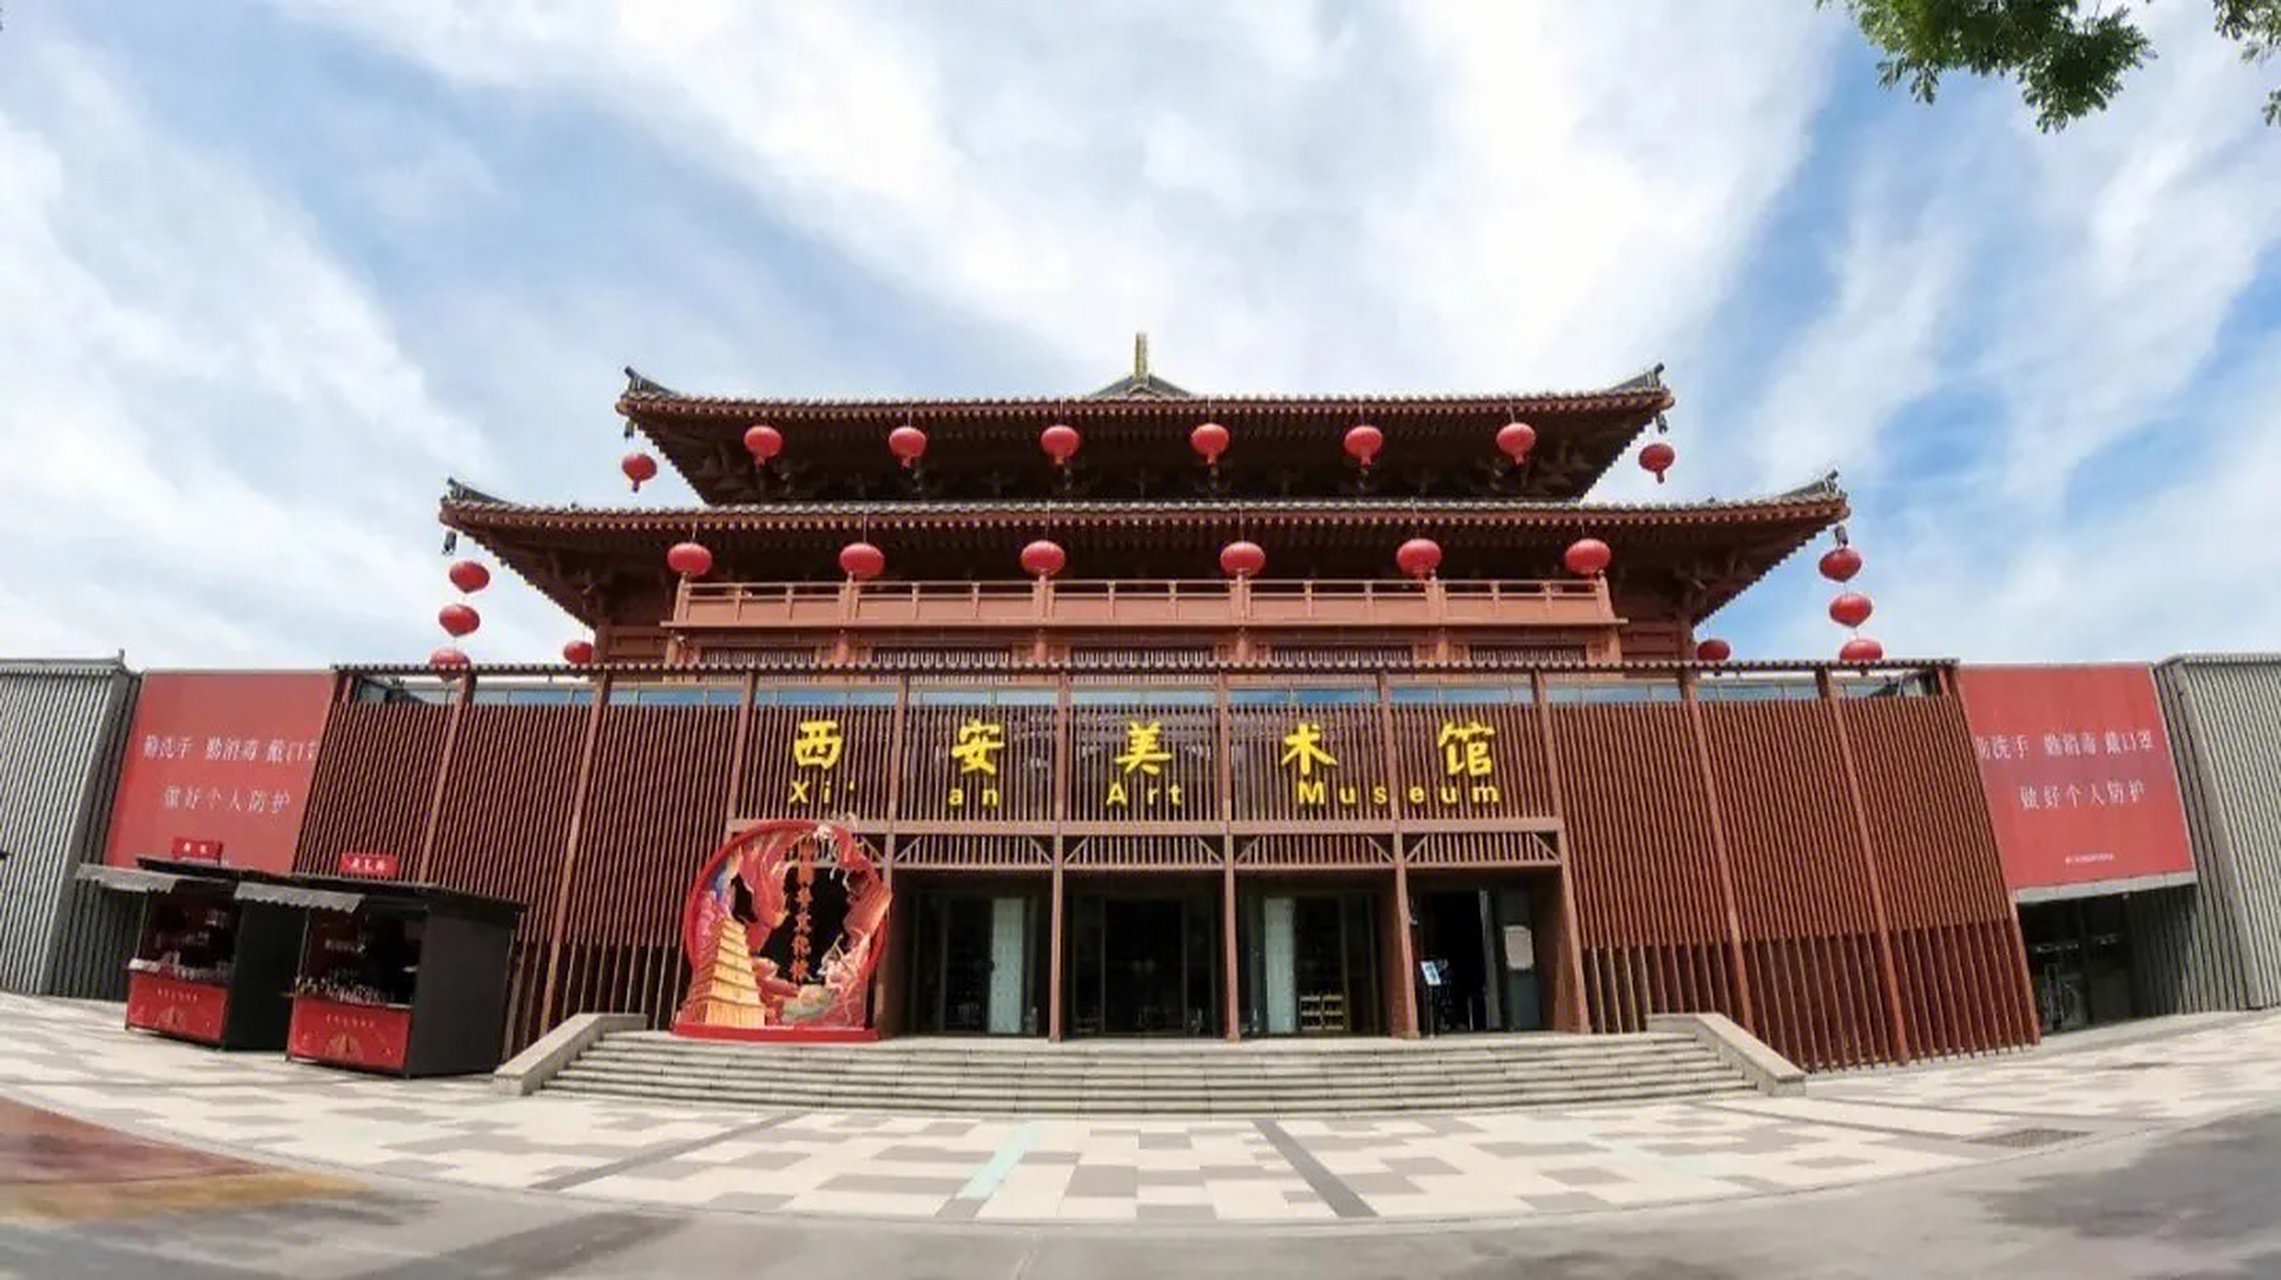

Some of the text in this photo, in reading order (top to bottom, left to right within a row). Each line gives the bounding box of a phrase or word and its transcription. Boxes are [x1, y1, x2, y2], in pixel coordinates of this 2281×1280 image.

[793, 720, 1497, 776] 西安美术馆
[2104, 729, 2153, 755] 戴口罩
[164, 784, 291, 814] 做好个人防护
[1106, 779, 1182, 806] Art
[1297, 780, 1501, 806] Museum
[2019, 778, 2144, 810] 做好个人防护
